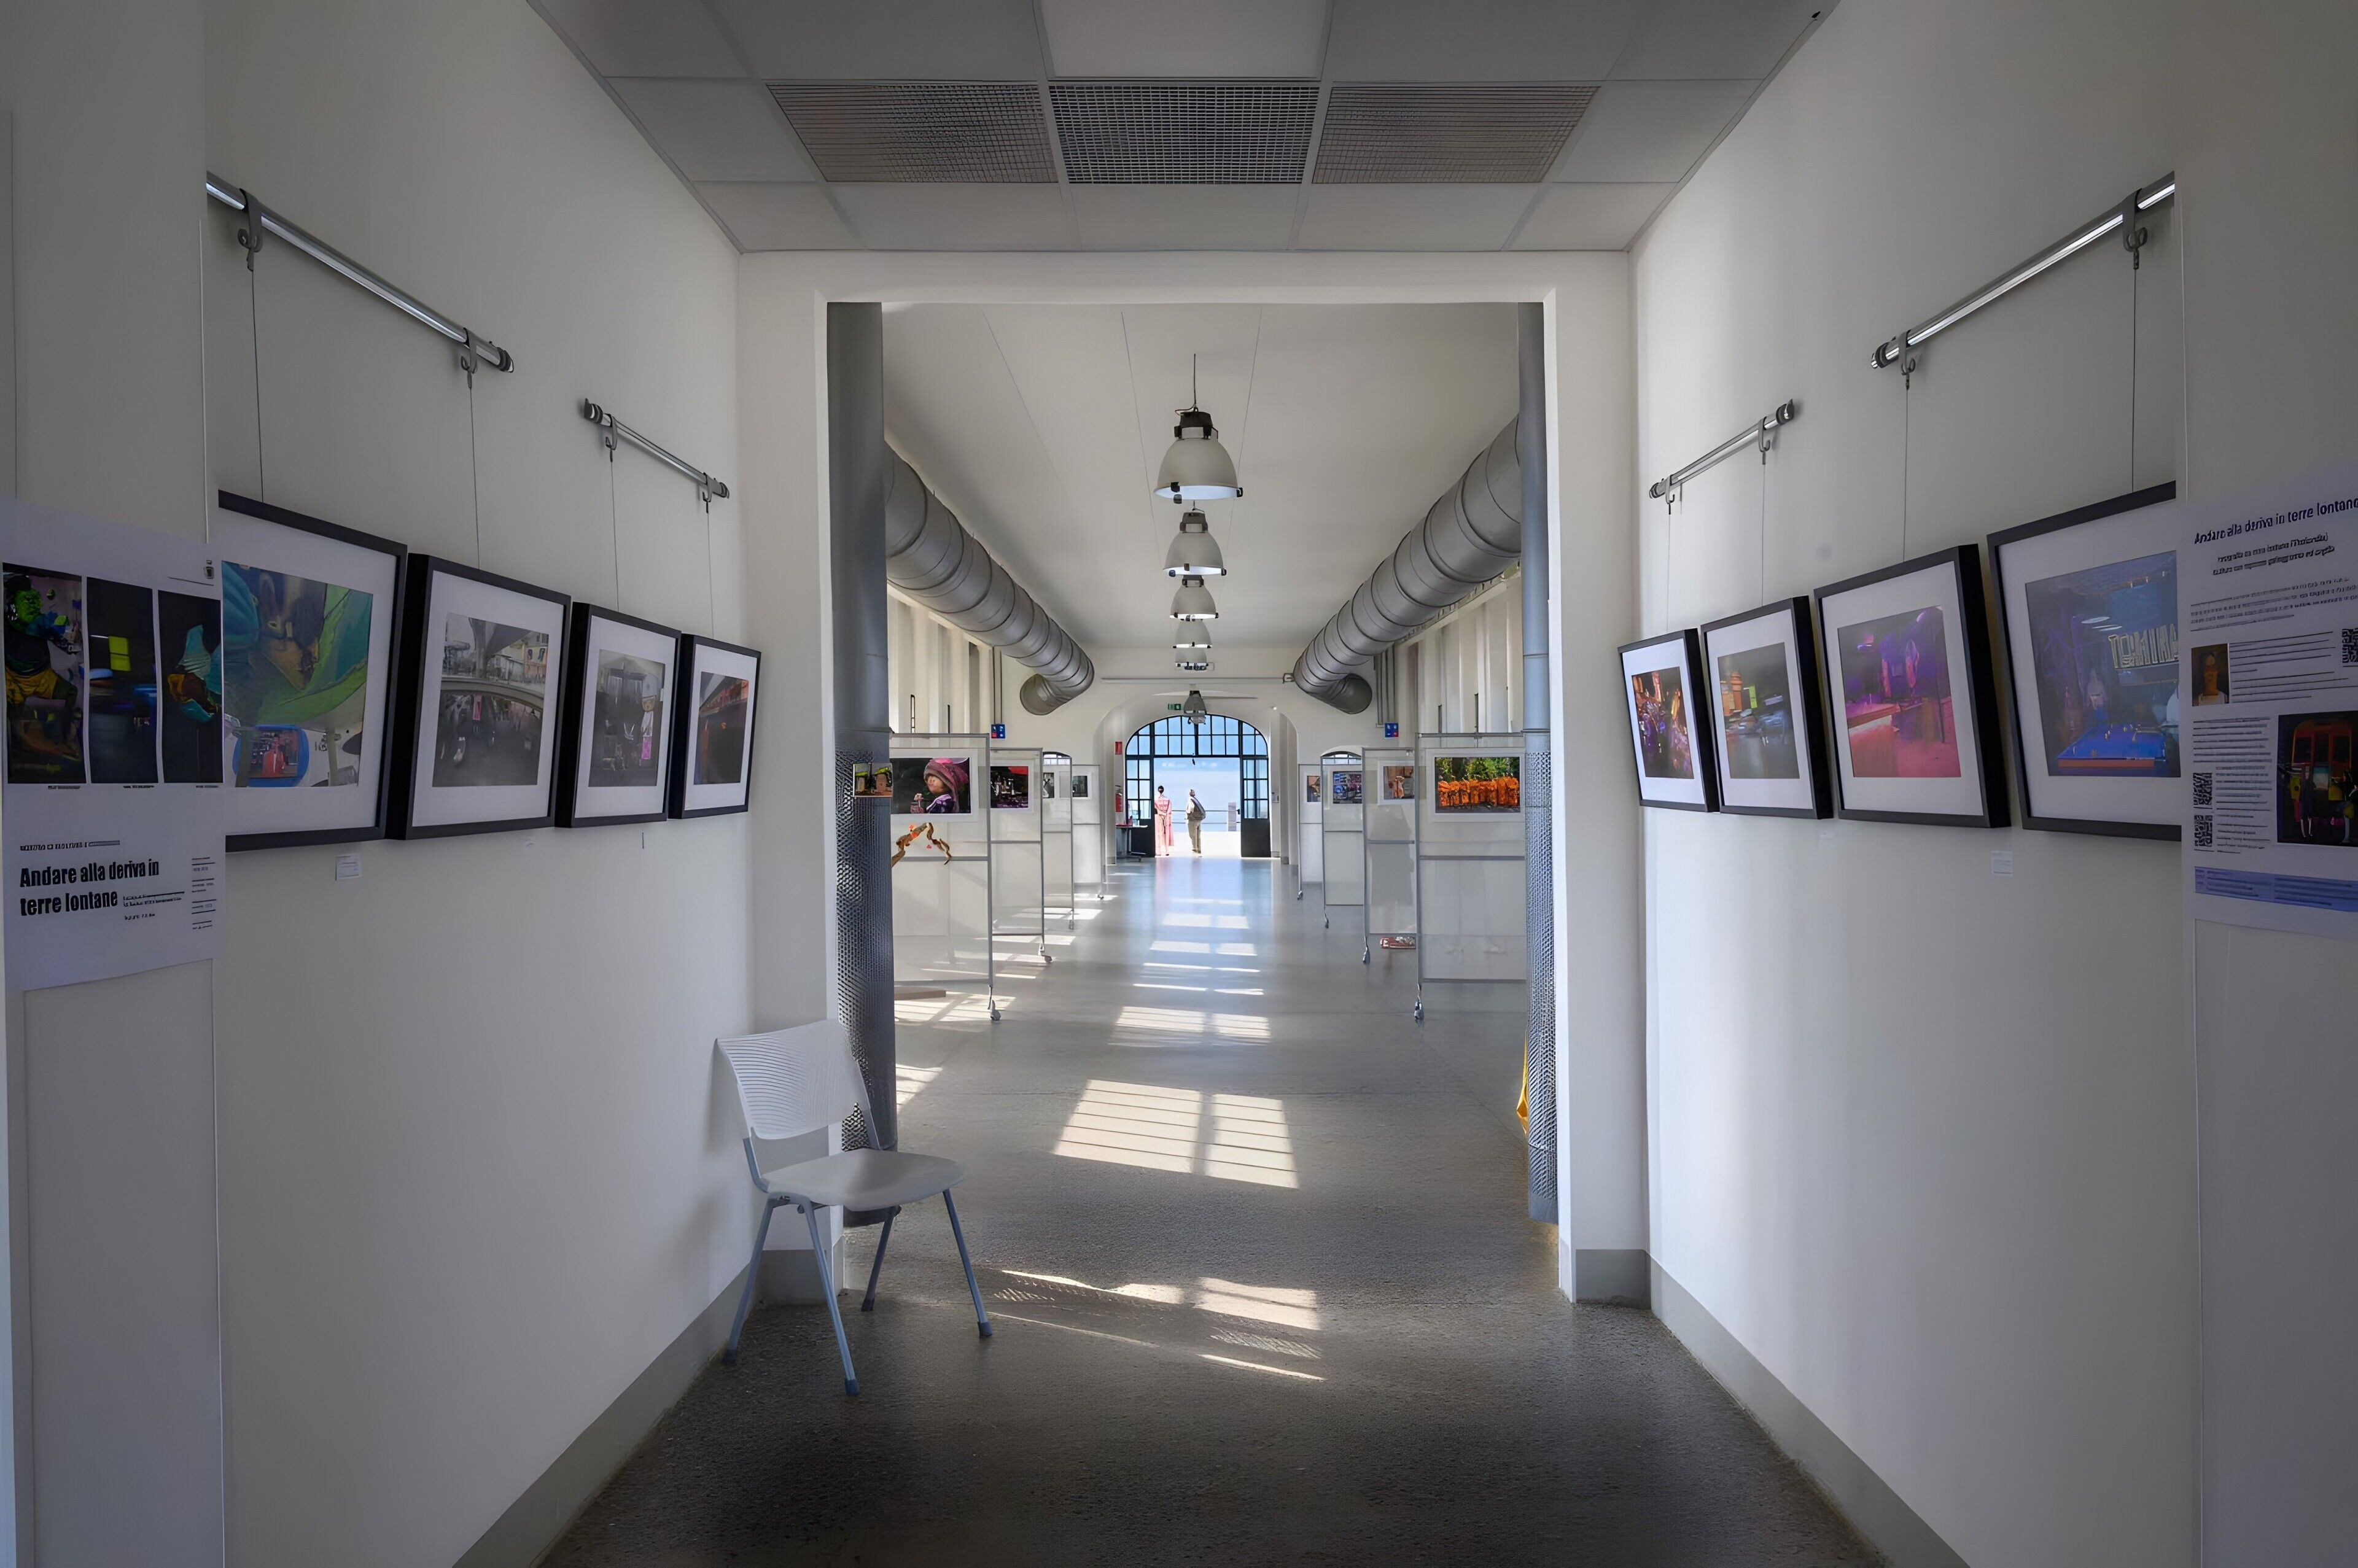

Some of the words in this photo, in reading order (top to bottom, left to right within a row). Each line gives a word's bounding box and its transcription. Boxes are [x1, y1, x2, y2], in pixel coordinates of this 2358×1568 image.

[2227, 524, 2242, 537] alla
[2276, 513, 2285, 525] in
[2288, 508, 2314, 522] terre
[20, 866, 77, 888] Andare
[80, 863, 106, 882] alla
[109, 861, 146, 880] deriva
[148, 858, 160, 875] in
[20, 896, 62, 917] terre
[65, 891, 118, 912] lontane
